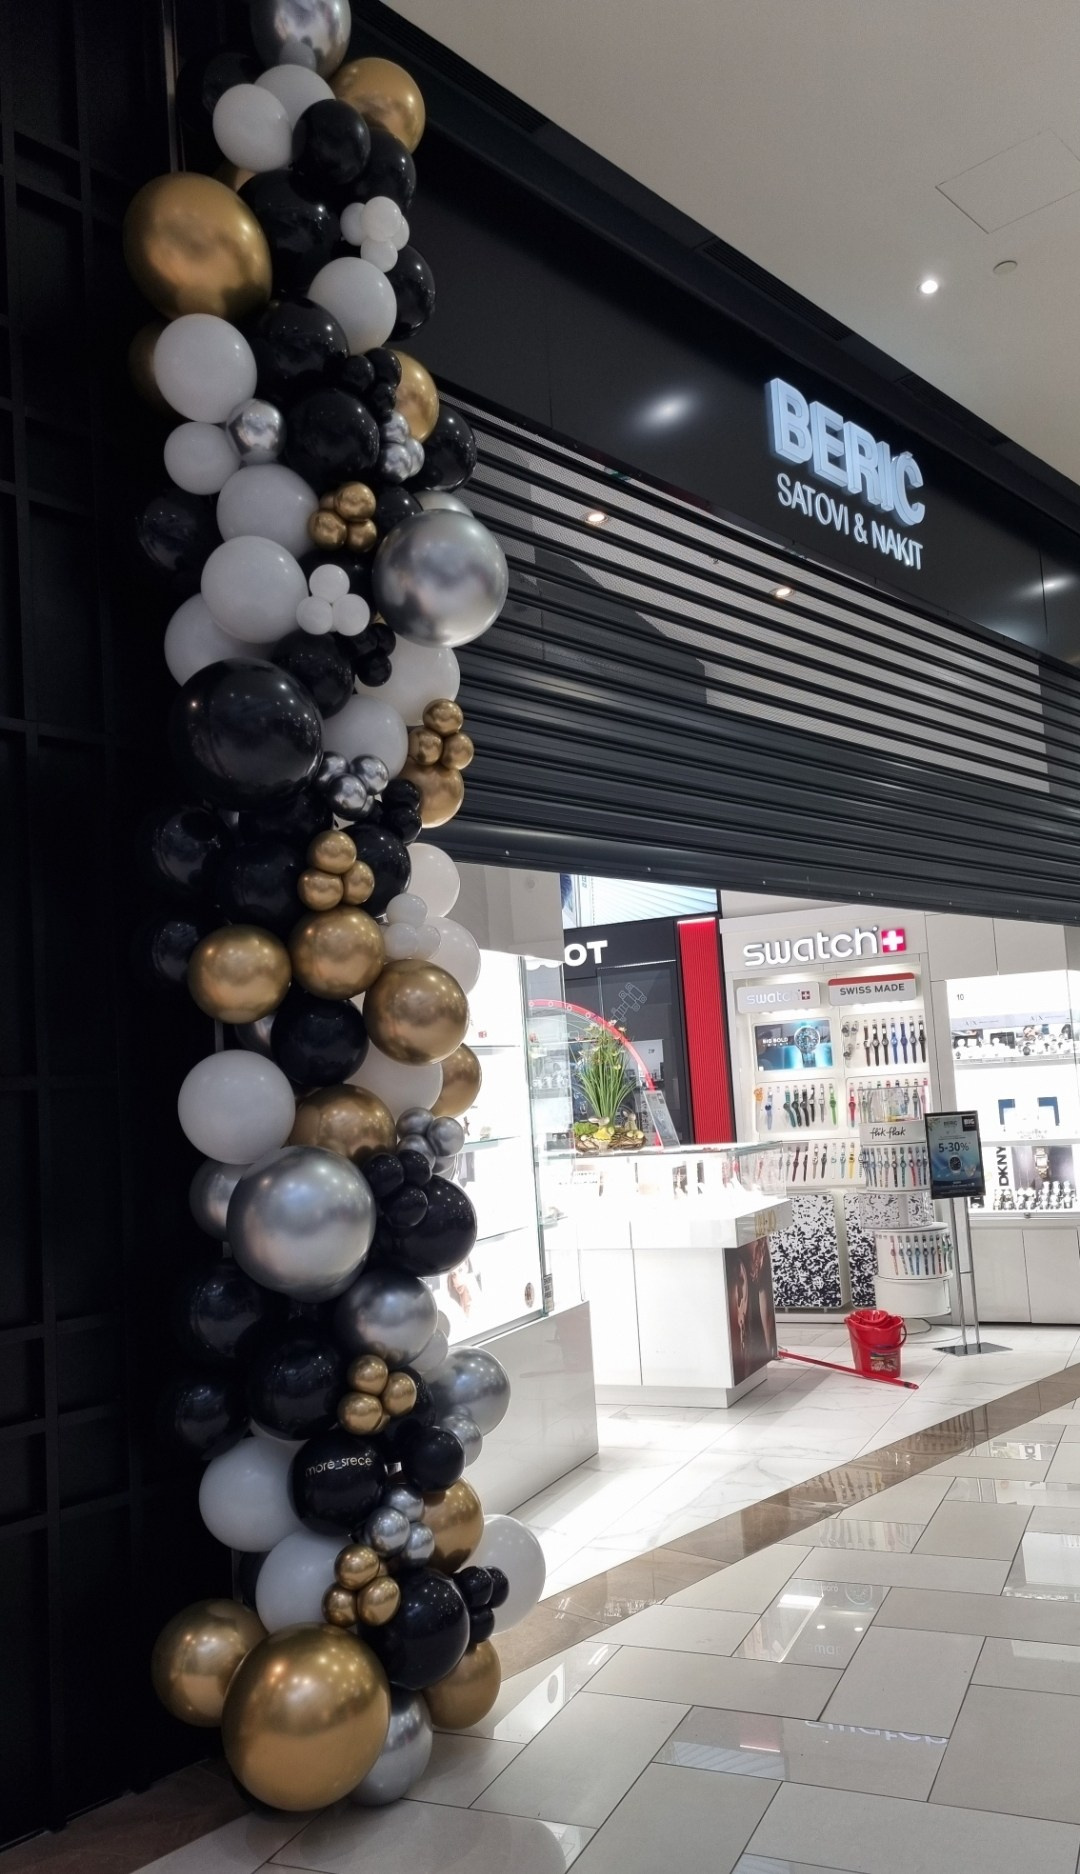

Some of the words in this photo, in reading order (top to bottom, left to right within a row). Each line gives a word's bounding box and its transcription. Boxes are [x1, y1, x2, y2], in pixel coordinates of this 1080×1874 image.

[777, 473, 850, 535] SATOVI
[854, 513, 868, 544] &
[871, 520, 923, 570] NAKIT
[743, 926, 879, 967] swatch
[747, 989, 801, 1005] swatc
[839, 986, 872, 996] SWISS
[874, 983, 905, 993] MADE
[996, 1146, 1009, 1186] DKNY
